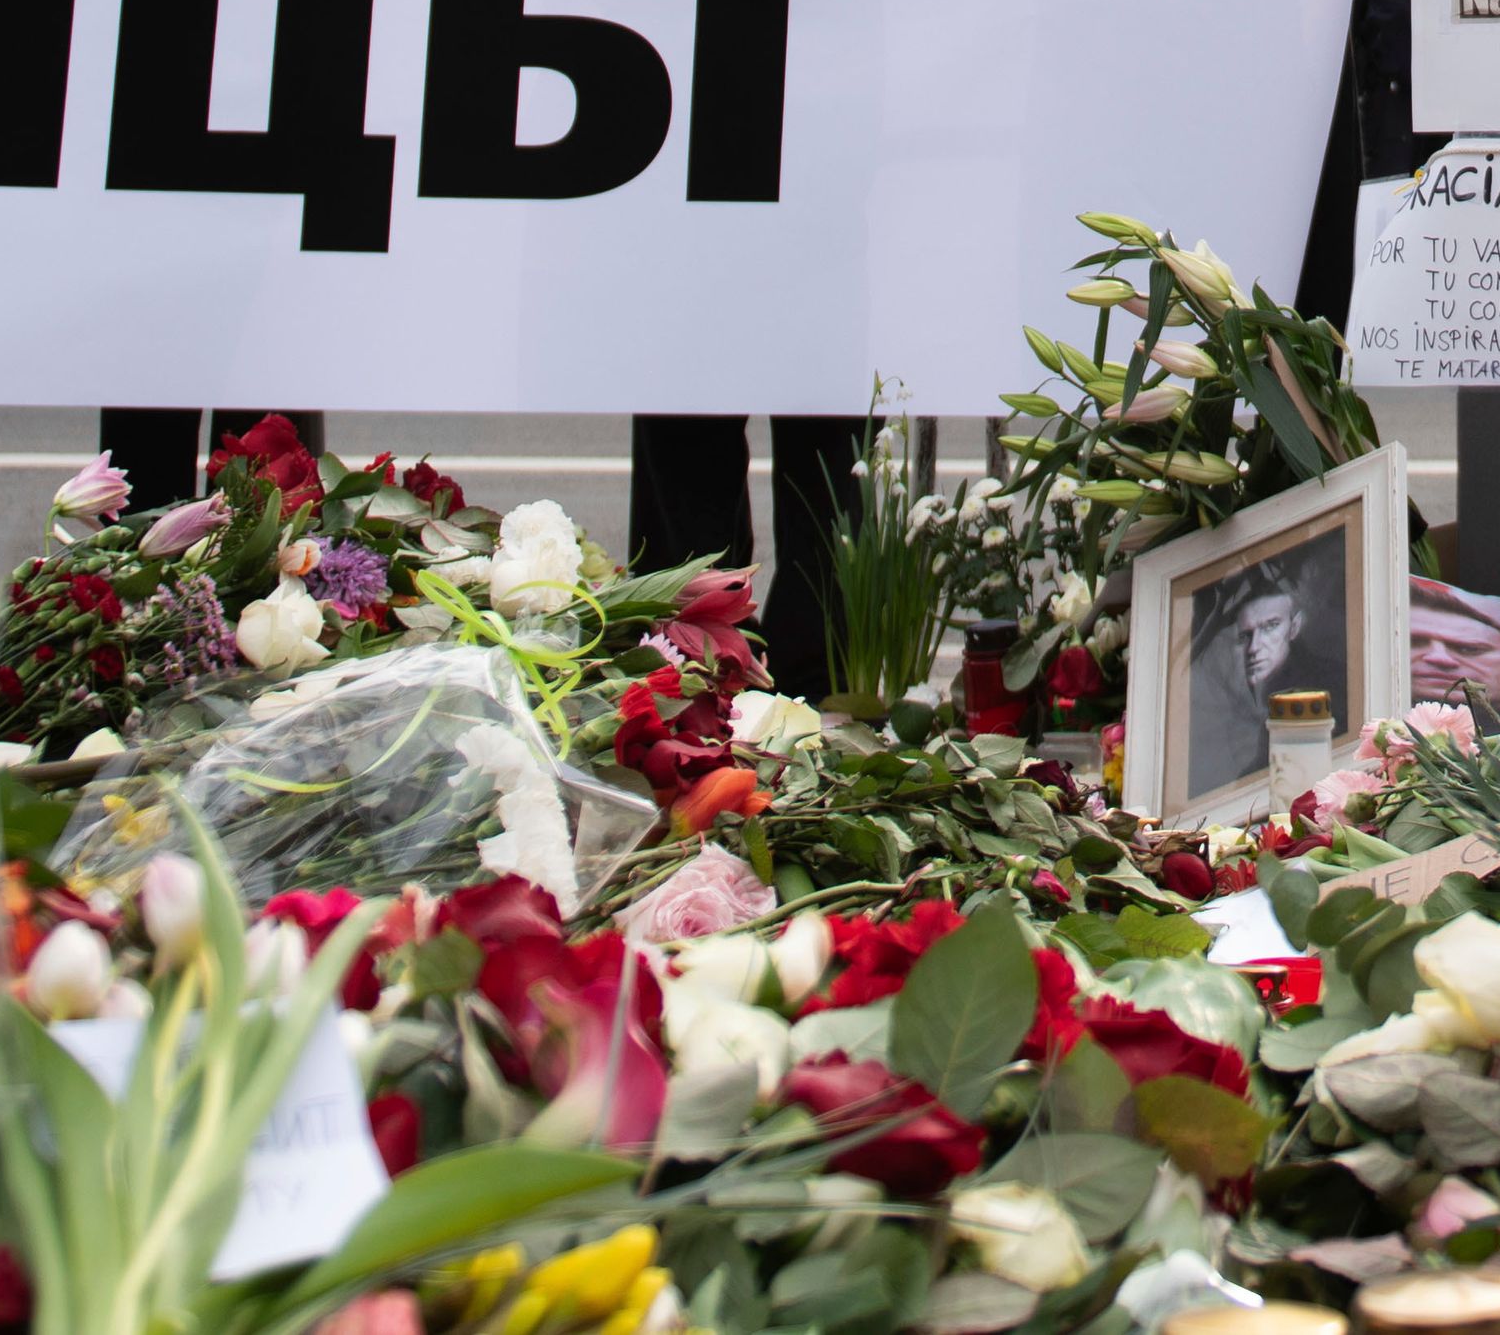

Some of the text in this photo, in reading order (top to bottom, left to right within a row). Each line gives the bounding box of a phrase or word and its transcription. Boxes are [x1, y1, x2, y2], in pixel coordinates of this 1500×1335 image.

[1370, 237, 1405, 266] POR
[1423, 236, 1457, 263] TU
[1425, 269, 1456, 291] TU
[1425, 298, 1456, 319] TU
[1360, 326, 1399, 350] NOS
[1395, 359, 1424, 379] TE
